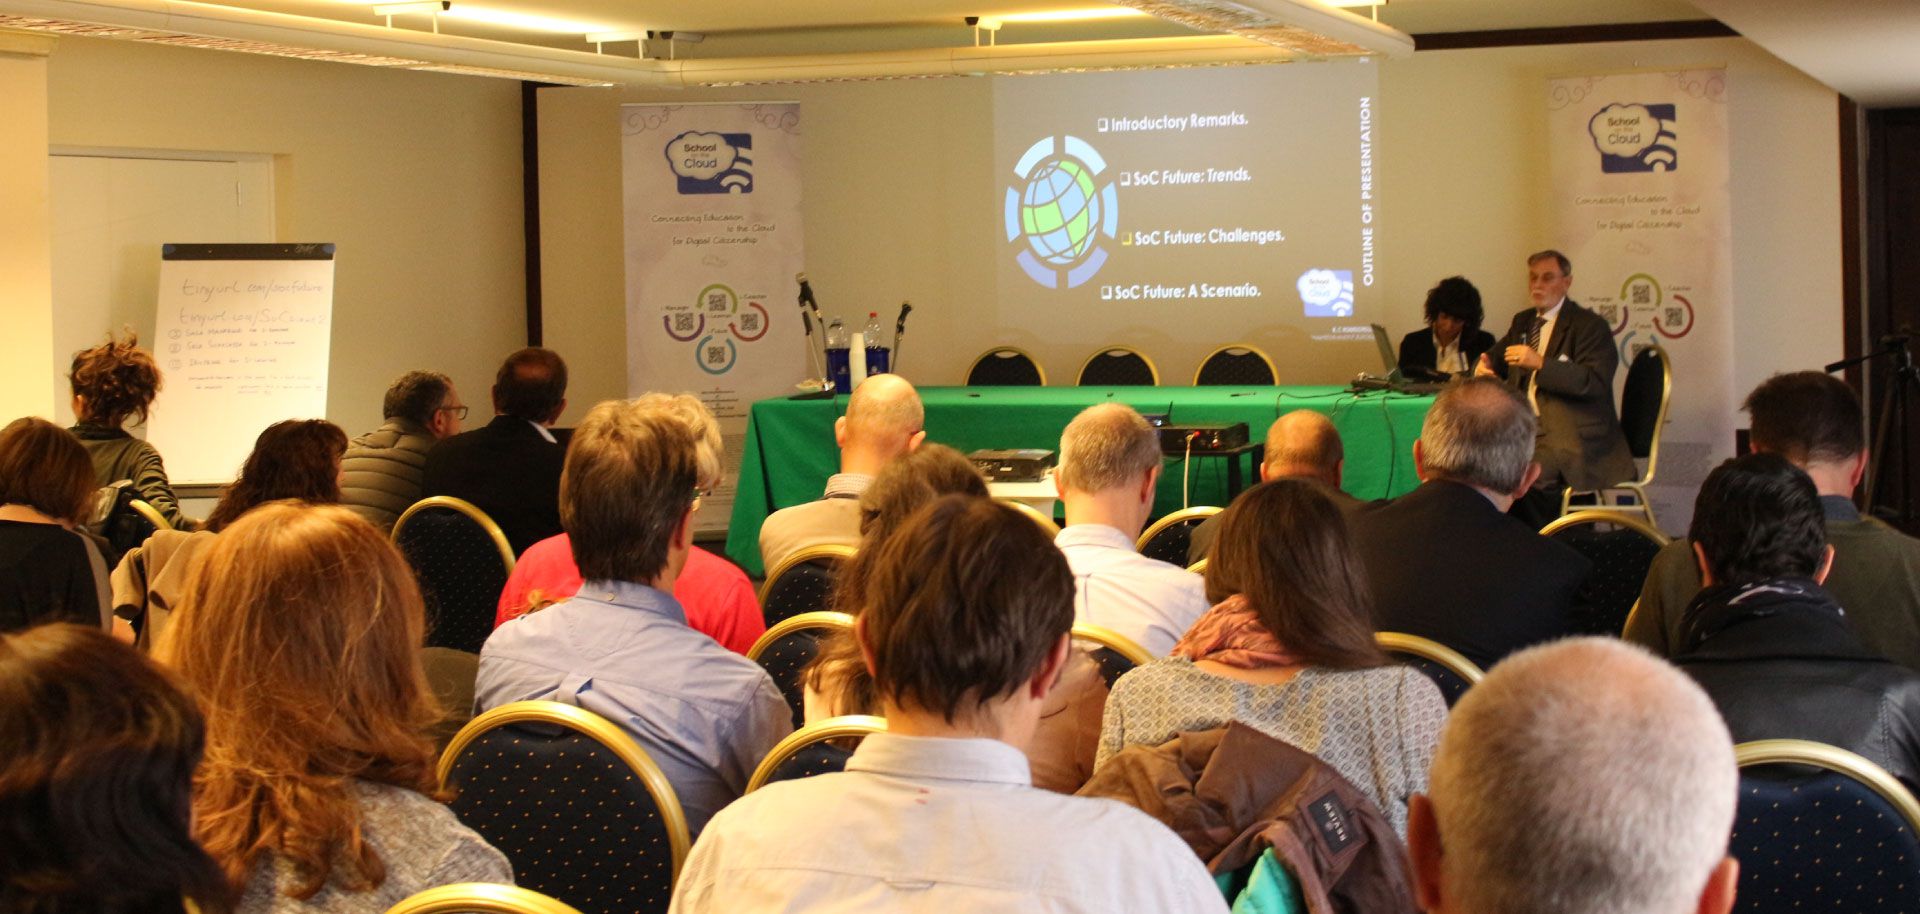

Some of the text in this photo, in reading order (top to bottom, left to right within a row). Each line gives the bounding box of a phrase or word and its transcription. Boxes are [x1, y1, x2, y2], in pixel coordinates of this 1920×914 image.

[1111, 111, 1248, 132] Introductory Remarks.
[1608, 117, 1640, 127] School
[1608, 133, 1640, 144] Cloud
[684, 143, 717, 153] School
[684, 158, 717, 169] Cloud
[1134, 166, 1251, 186] SoC Future: Trends.
[1360, 96, 1374, 287] OUTLINE OF PRESENTATION
[1675, 205, 1700, 215] Cloud
[652, 213, 743, 224] Connecting Education
[736, 224, 749, 232] the
[751, 224, 775, 232] Cloud
[686, 236, 710, 247] Digital
[1135, 228, 1285, 246] SoC Future: Challenges.
[1115, 282, 1261, 300] SoC Future: A Scenario.
[1323, 802, 1348, 842] REVIEW
